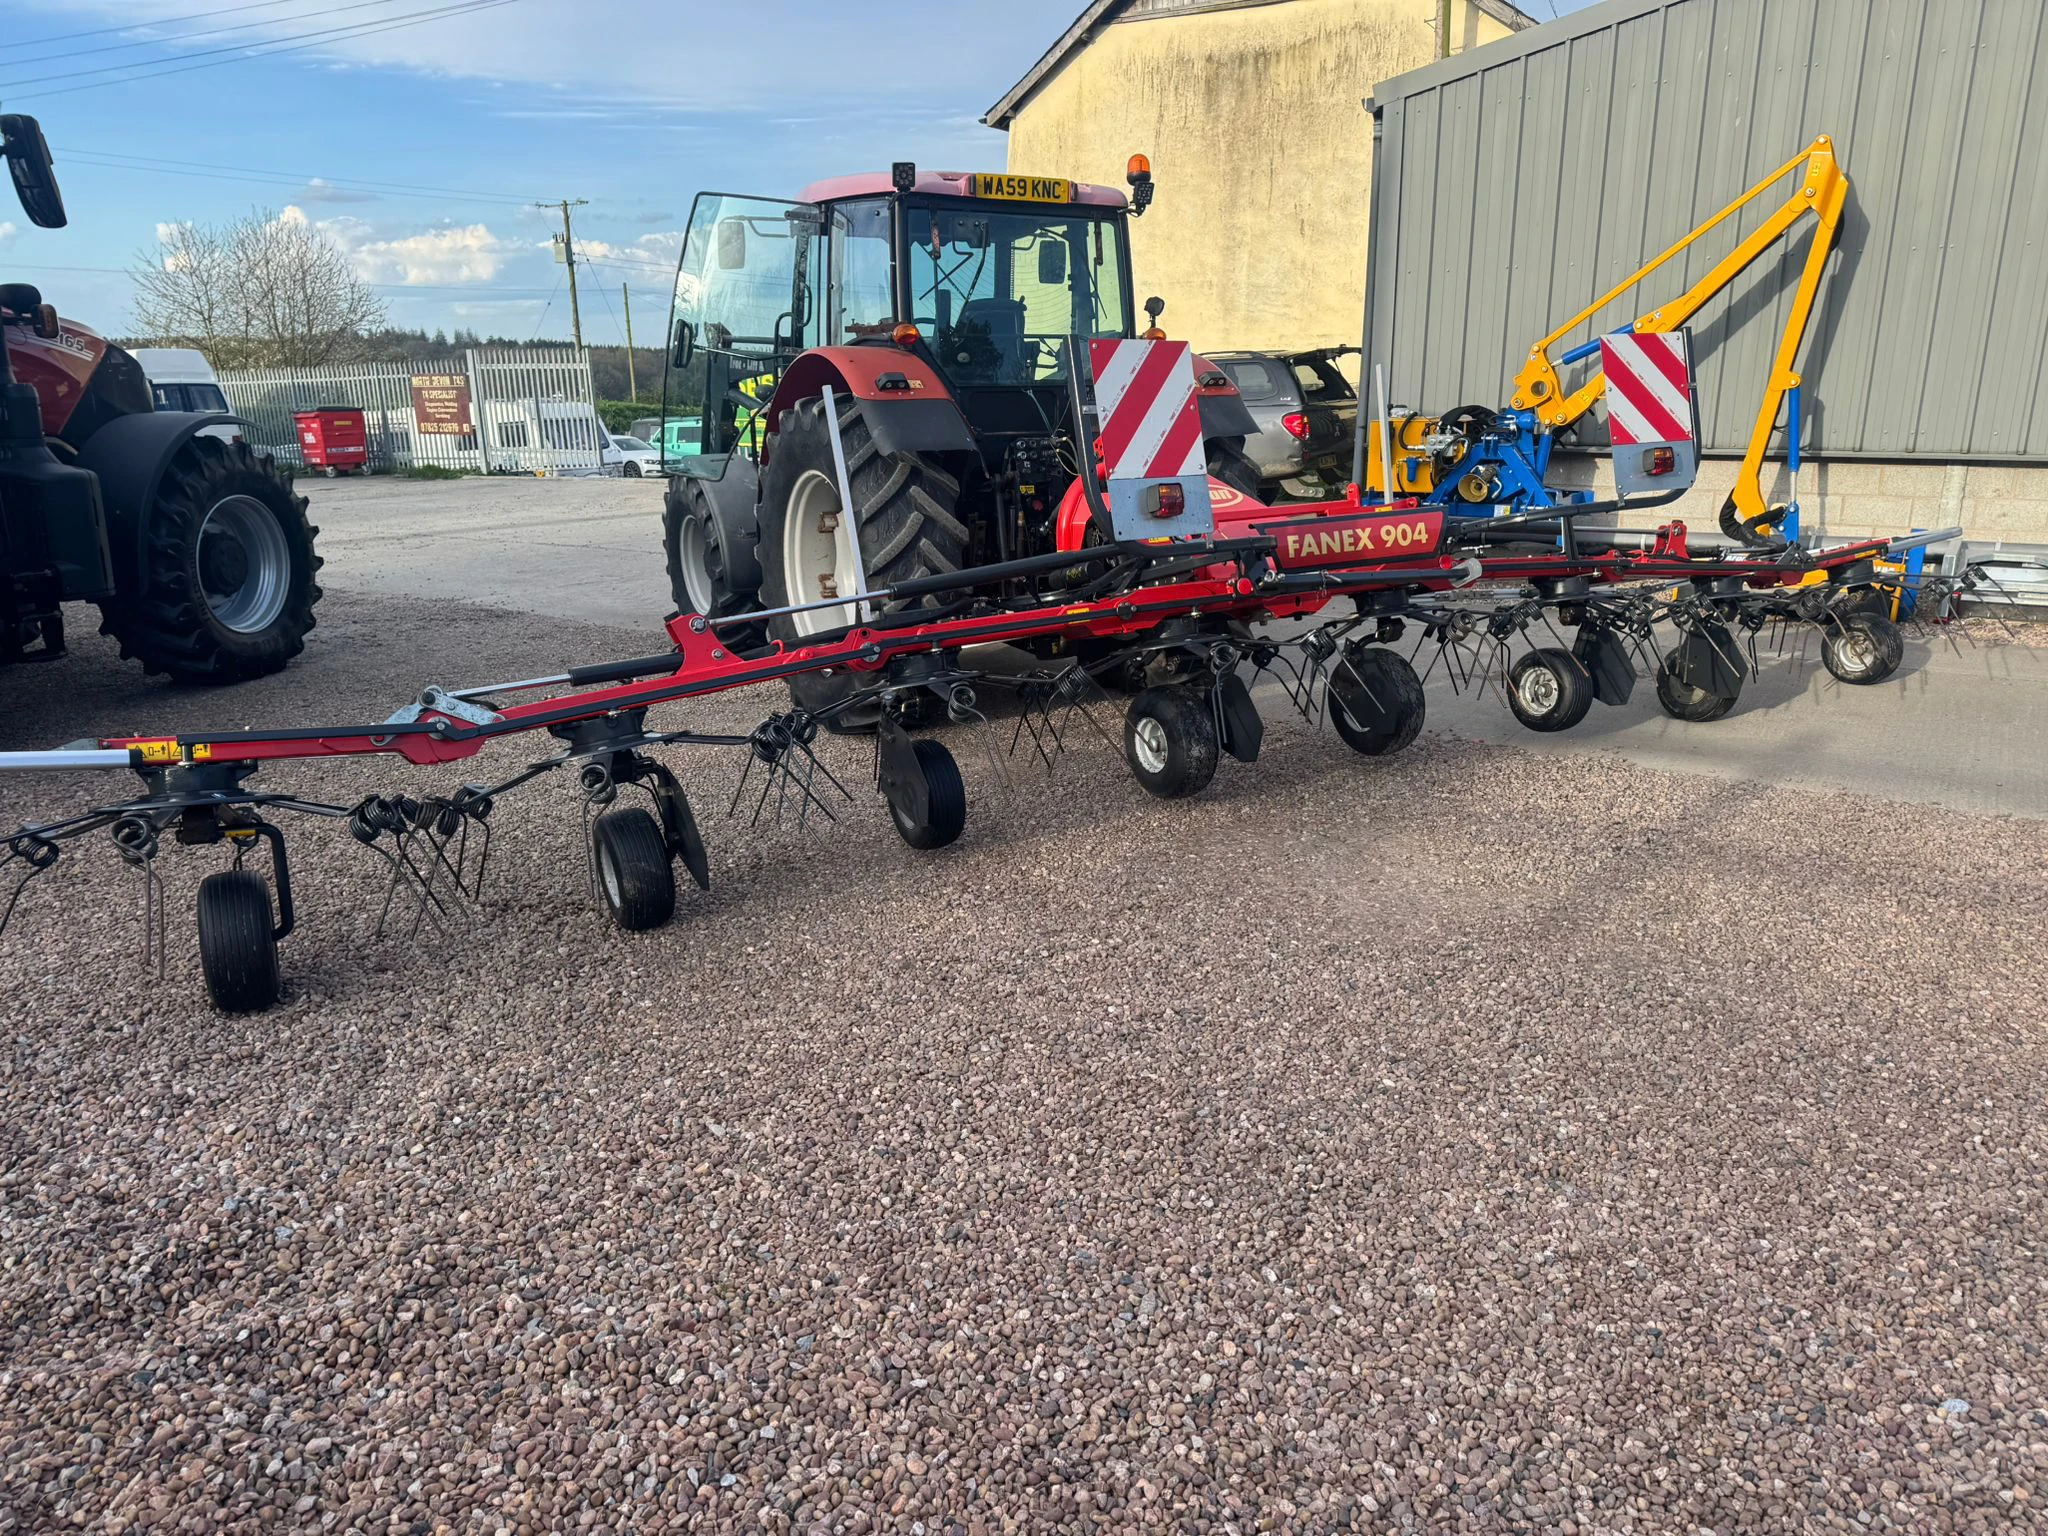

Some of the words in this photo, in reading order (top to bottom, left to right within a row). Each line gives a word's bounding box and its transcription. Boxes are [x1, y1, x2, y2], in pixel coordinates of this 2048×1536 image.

[983, 176, 1027, 197] WA59
[1031, 179, 1061, 199] KNC
[58, 332, 84, 352] 165
[429, 390, 457, 399] SPECIALIST
[1287, 527, 1375, 559] FANEX
[1379, 521, 1429, 549] 904
